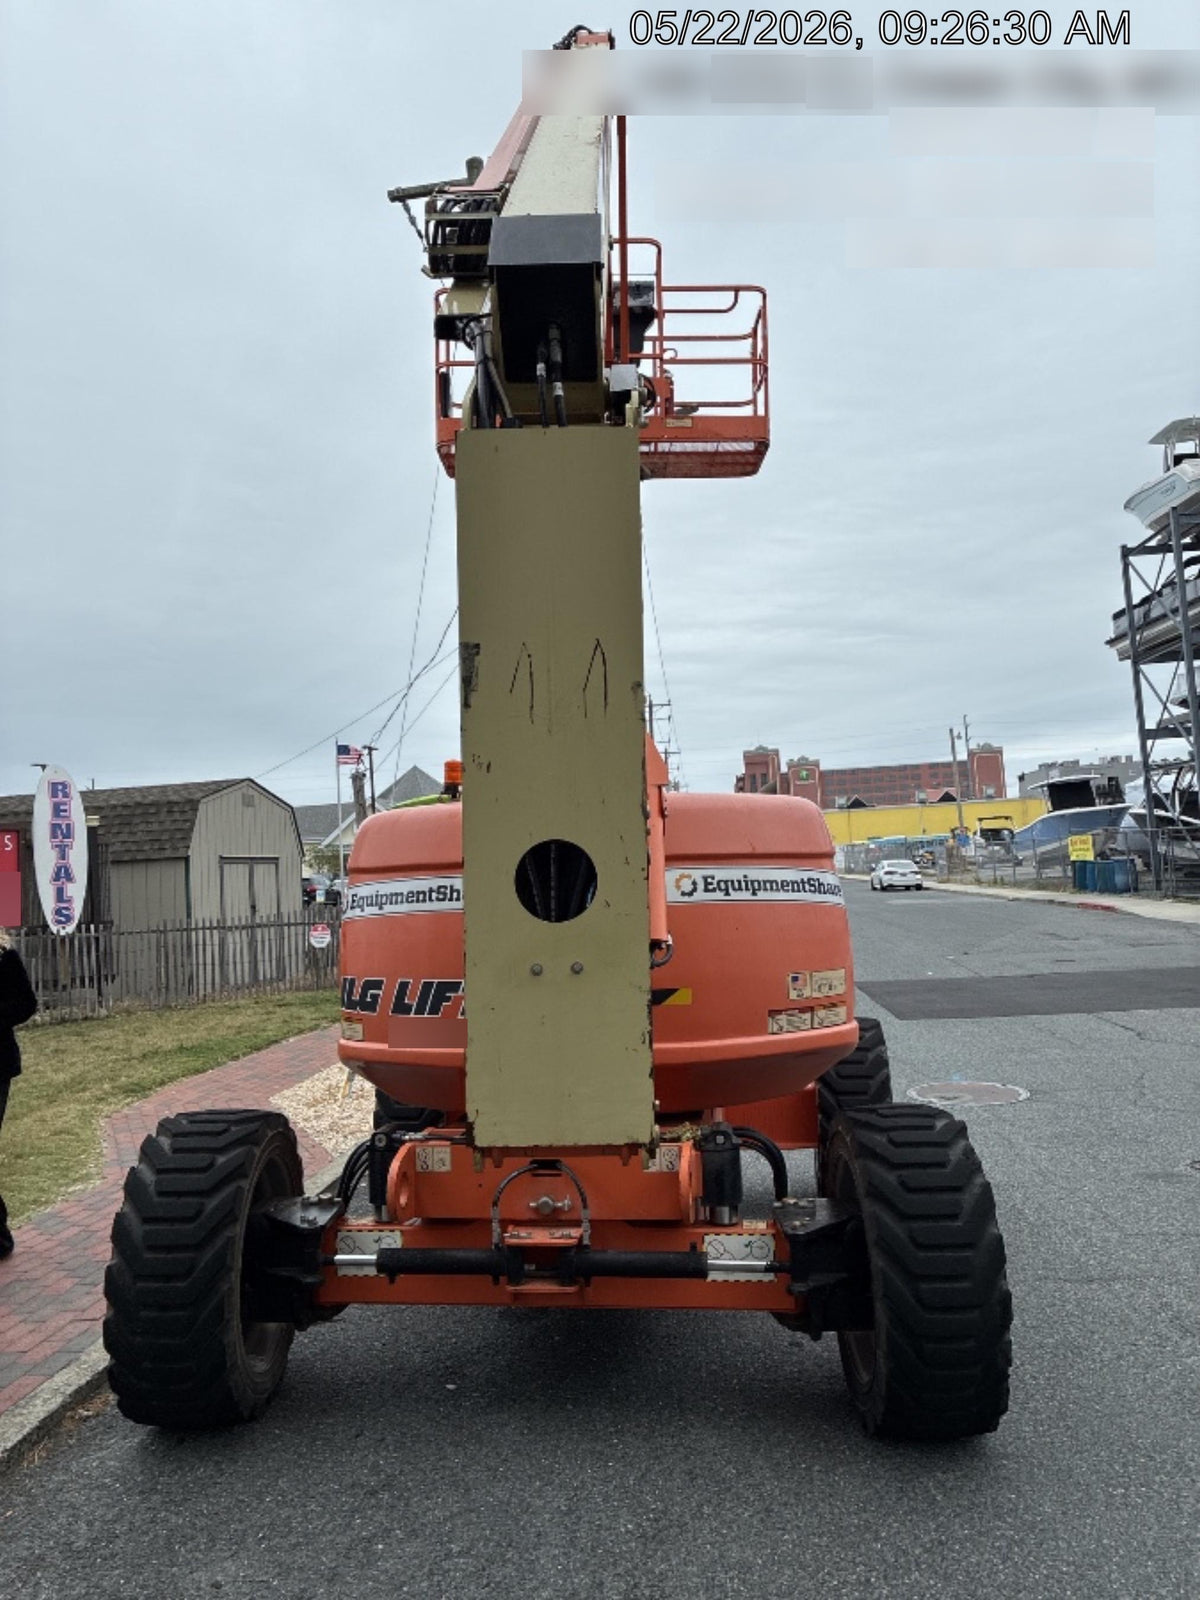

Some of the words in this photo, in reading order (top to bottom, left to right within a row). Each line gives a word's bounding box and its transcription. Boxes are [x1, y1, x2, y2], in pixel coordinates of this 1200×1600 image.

[48, 780, 76, 927] RENTALS
[349, 884, 464, 912] EquipmentSh
[389, 978, 465, 1019] LIF
